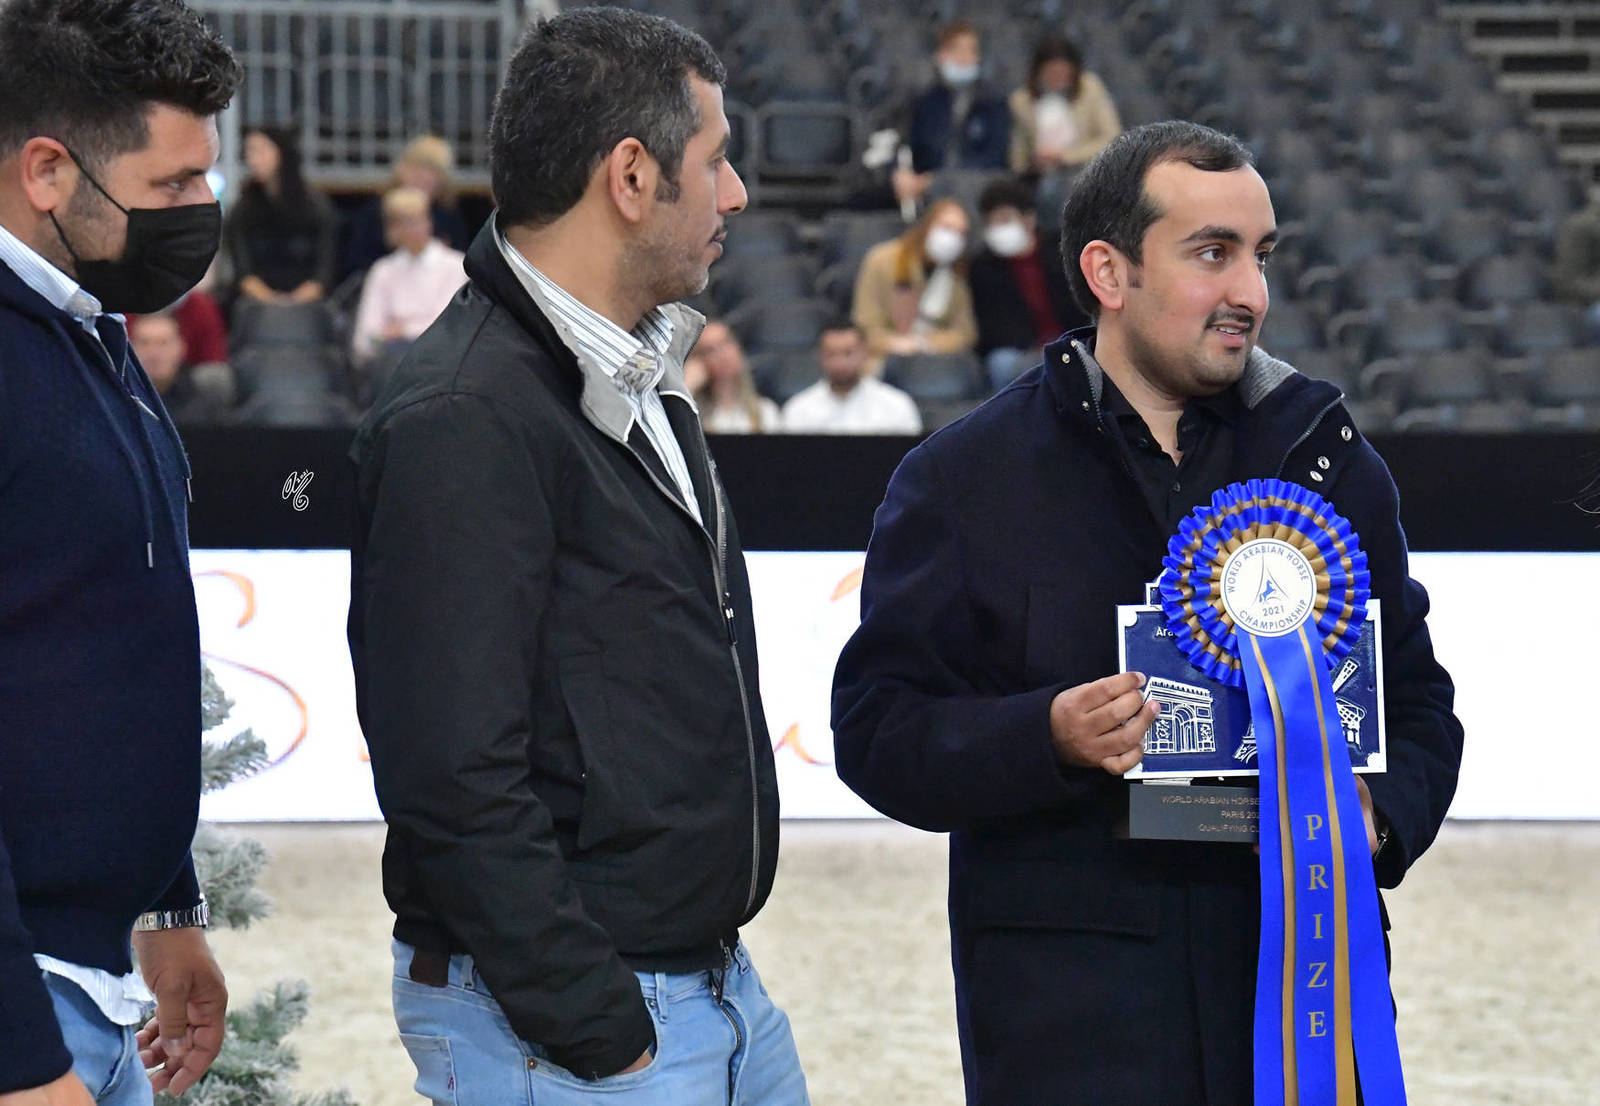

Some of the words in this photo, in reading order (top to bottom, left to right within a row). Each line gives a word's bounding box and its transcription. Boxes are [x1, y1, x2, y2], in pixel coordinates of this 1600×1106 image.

[1227, 560, 1242, 593] WORLD
[1243, 545, 1285, 561] ARABIAN
[1286, 552, 1309, 581] HORSE
[1239, 599, 1307, 630] CHAMPIONSHIP
[1262, 605, 1285, 617] 2021
[1161, 795, 1192, 804] WORLD
[1193, 796, 1230, 805] ARABIAN
[1220, 810, 1245, 819] PARIS
[1304, 814, 1329, 1038] PRIZE
